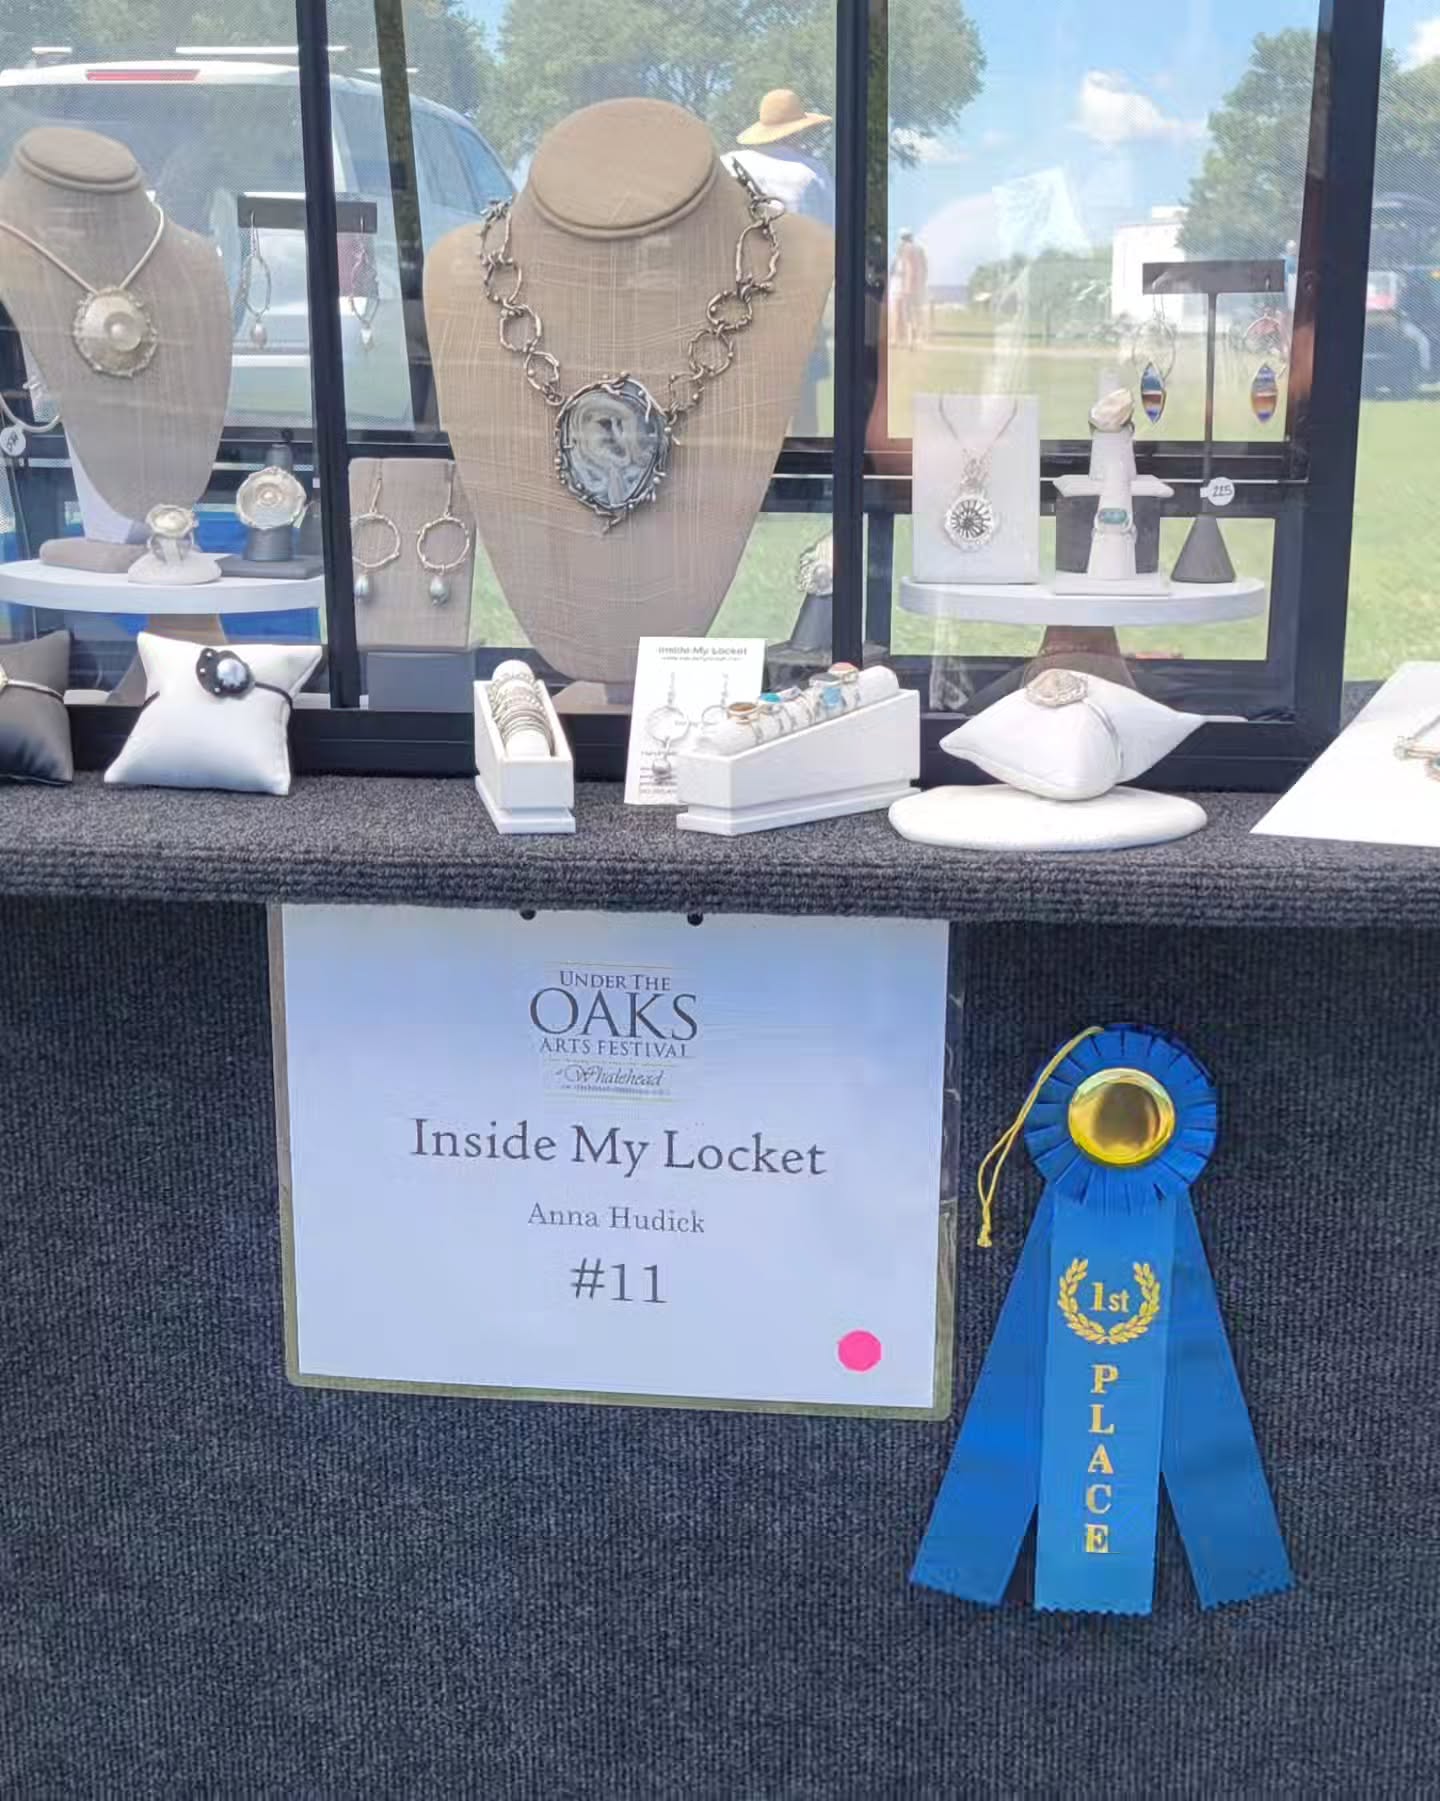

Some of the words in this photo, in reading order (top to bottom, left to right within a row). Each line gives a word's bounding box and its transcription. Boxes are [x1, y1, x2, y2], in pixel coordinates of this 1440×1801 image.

[560, 970, 626, 988] UNDER
[632, 974, 671, 990] THE
[529, 987, 698, 1041] OAKS
[540, 1038, 591, 1055] ARTS
[598, 1041, 689, 1058] FESTIVAL
[410, 1117, 557, 1161] Inside
[570, 1124, 650, 1178] My
[663, 1130, 828, 1175] Locket
[528, 1202, 600, 1227] Anna
[608, 1206, 705, 1234] Hudick
[570, 1257, 668, 1304] #11
[1089, 1282, 1131, 1313] 1st
[1085, 1364, 1119, 1553] PLACE
